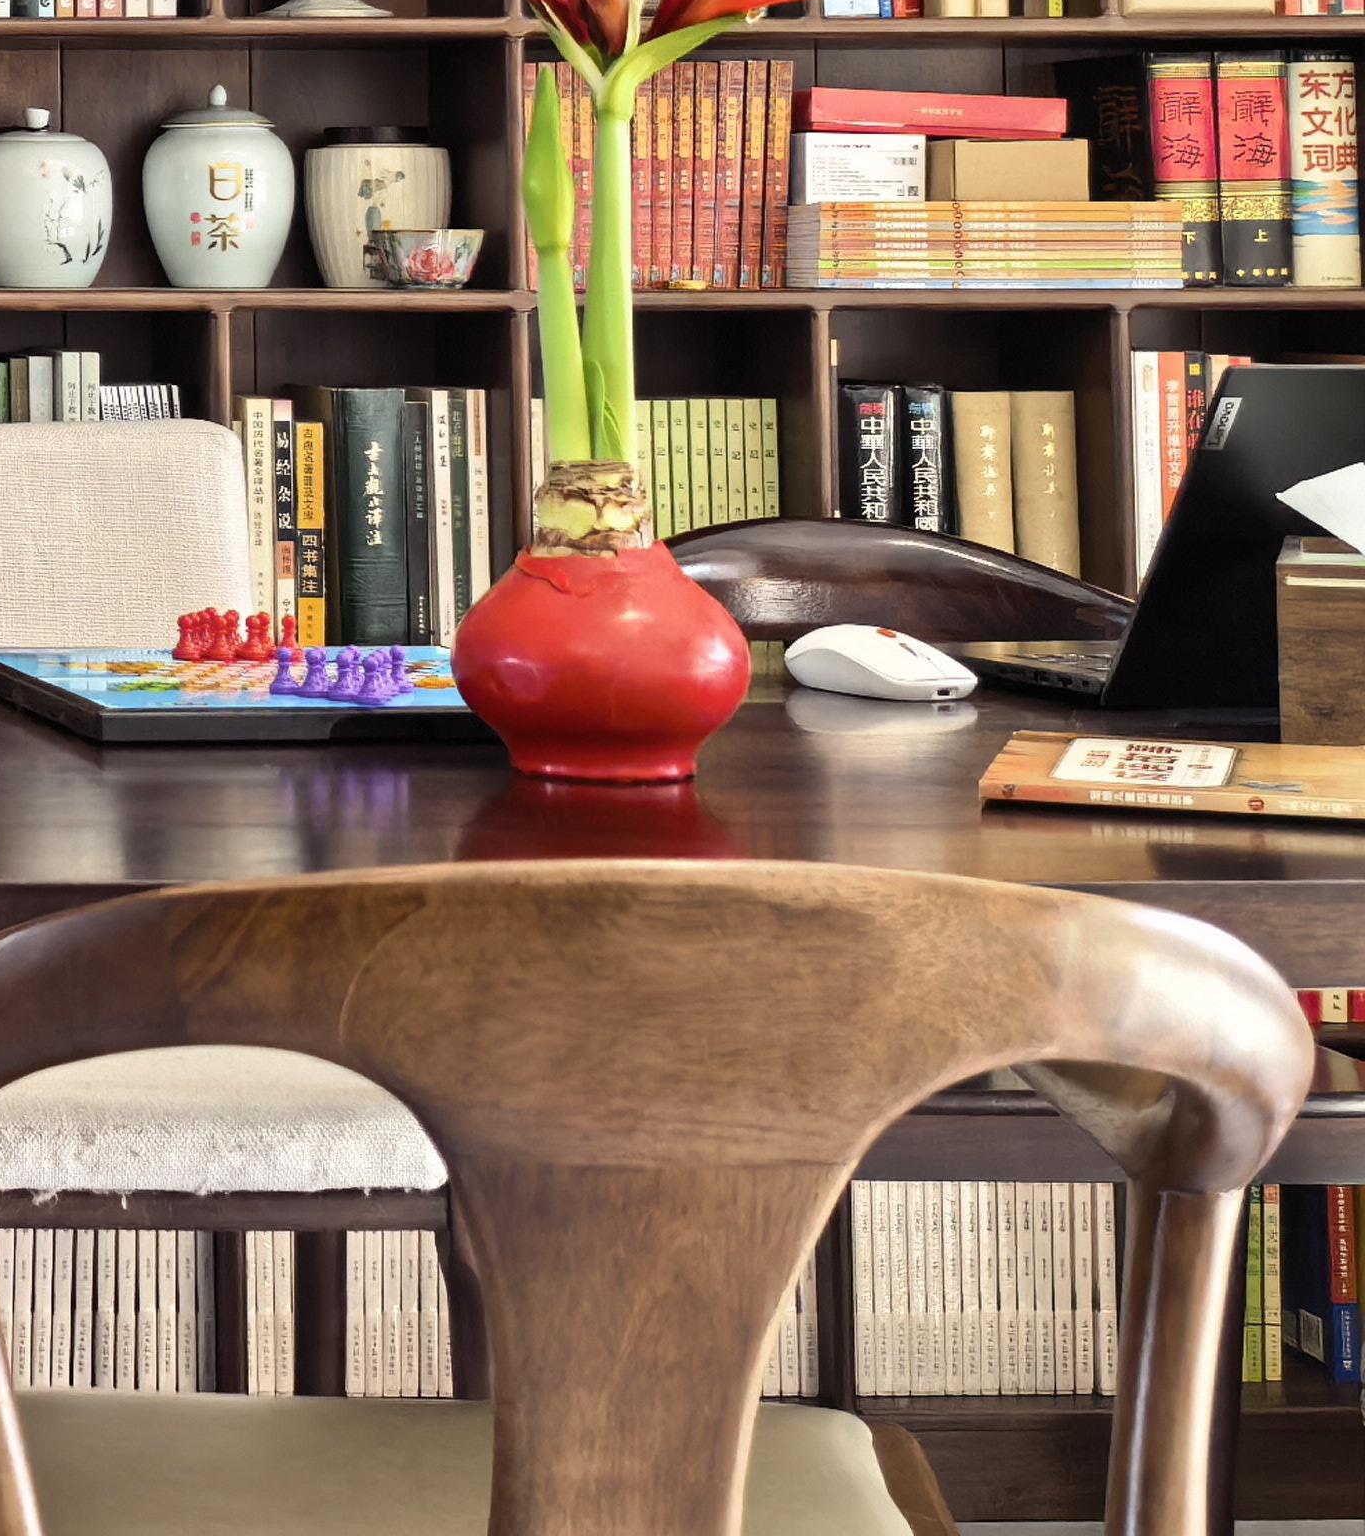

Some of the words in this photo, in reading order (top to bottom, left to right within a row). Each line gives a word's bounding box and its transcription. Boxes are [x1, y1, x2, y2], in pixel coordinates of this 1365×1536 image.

[1299, 70, 1355, 100] 东方
[1301, 107, 1357, 136] 文化
[1303, 144, 1358, 173] 词典
[205, 162, 243, 252] 白茶
[1182, 231, 1196, 244] 下
[1254, 229, 1268, 243] 上
[276, 432, 292, 529] 易经杂说
[301, 534, 318, 595] 四书集注
